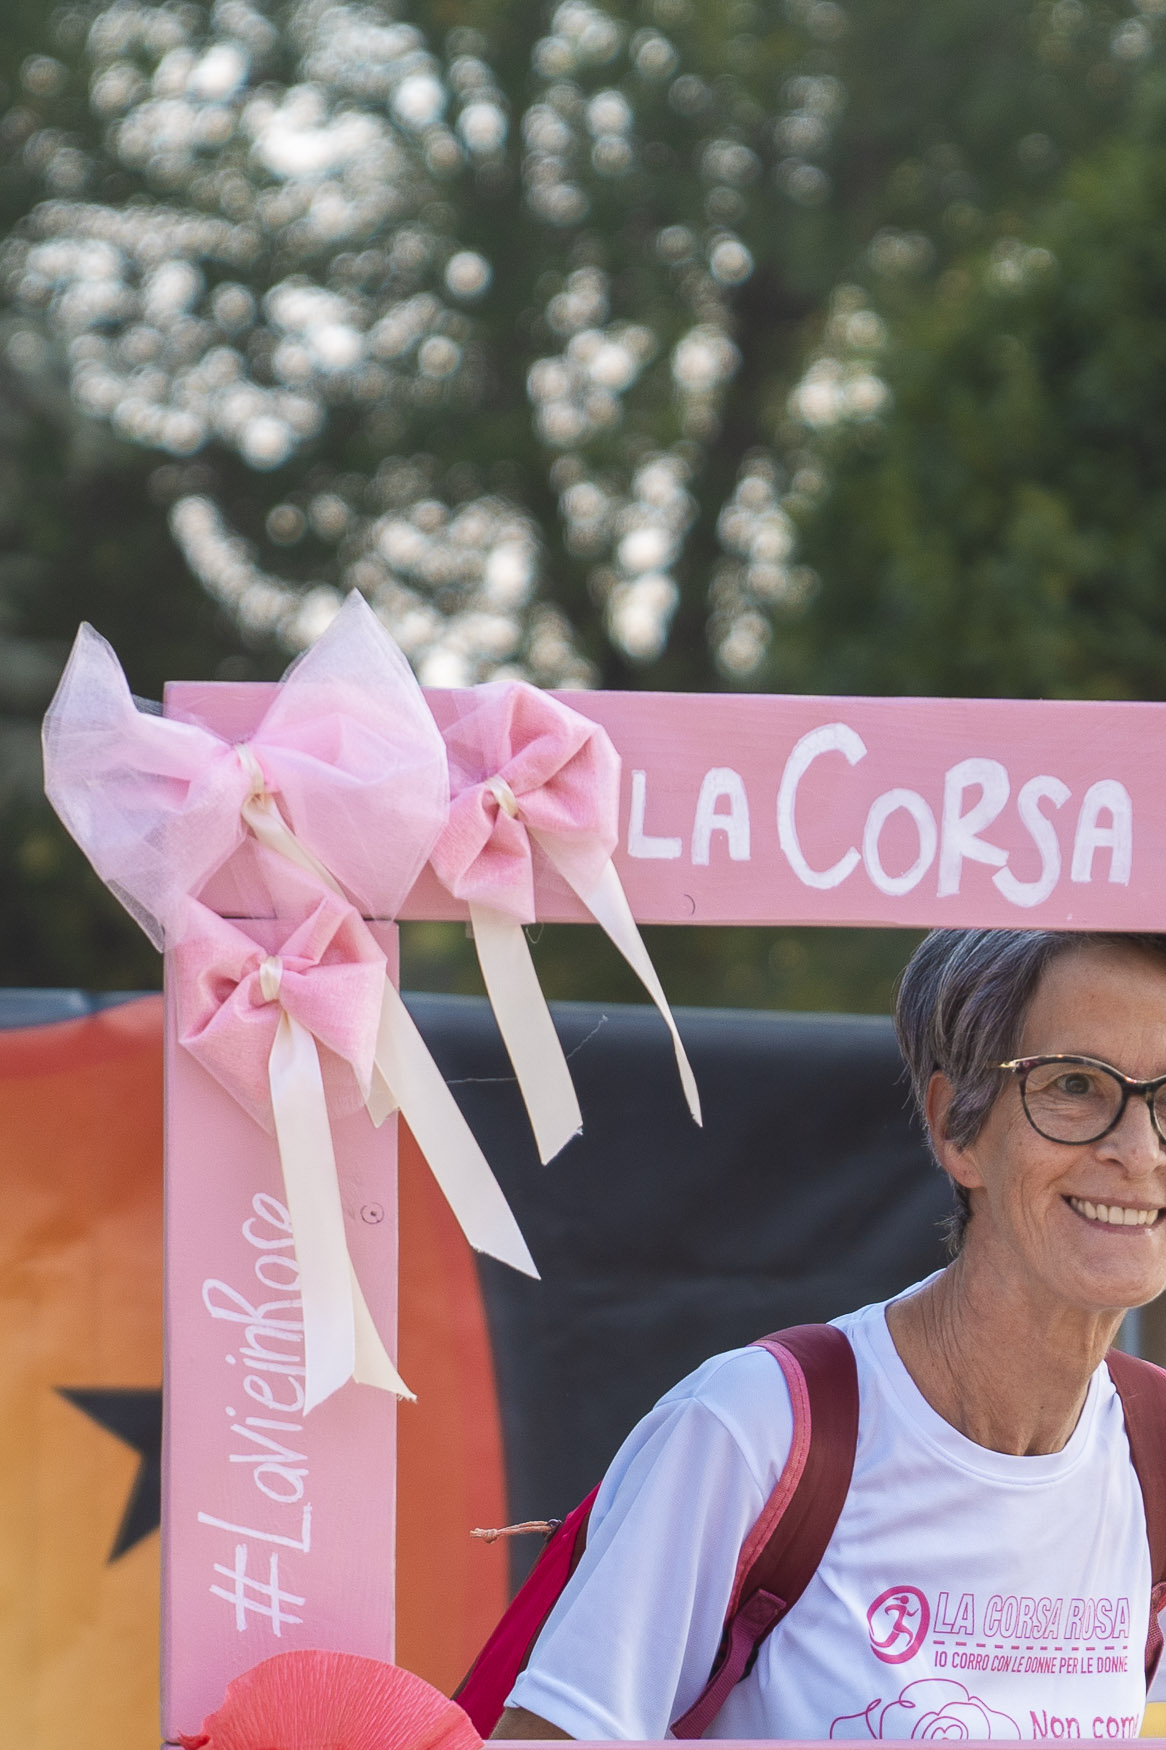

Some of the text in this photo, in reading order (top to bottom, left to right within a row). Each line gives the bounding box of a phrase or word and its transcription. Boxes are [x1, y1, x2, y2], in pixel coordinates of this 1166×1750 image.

[627, 768, 751, 866] LA
[776, 722, 1134, 908] CORSA
[933, 1592, 1130, 1640] LA CORSA ROSA
[934, 1650, 1128, 1674] IO CORRO CON LE DONNE PER LE DONNE
[1029, 1709, 1080, 1739] Non
